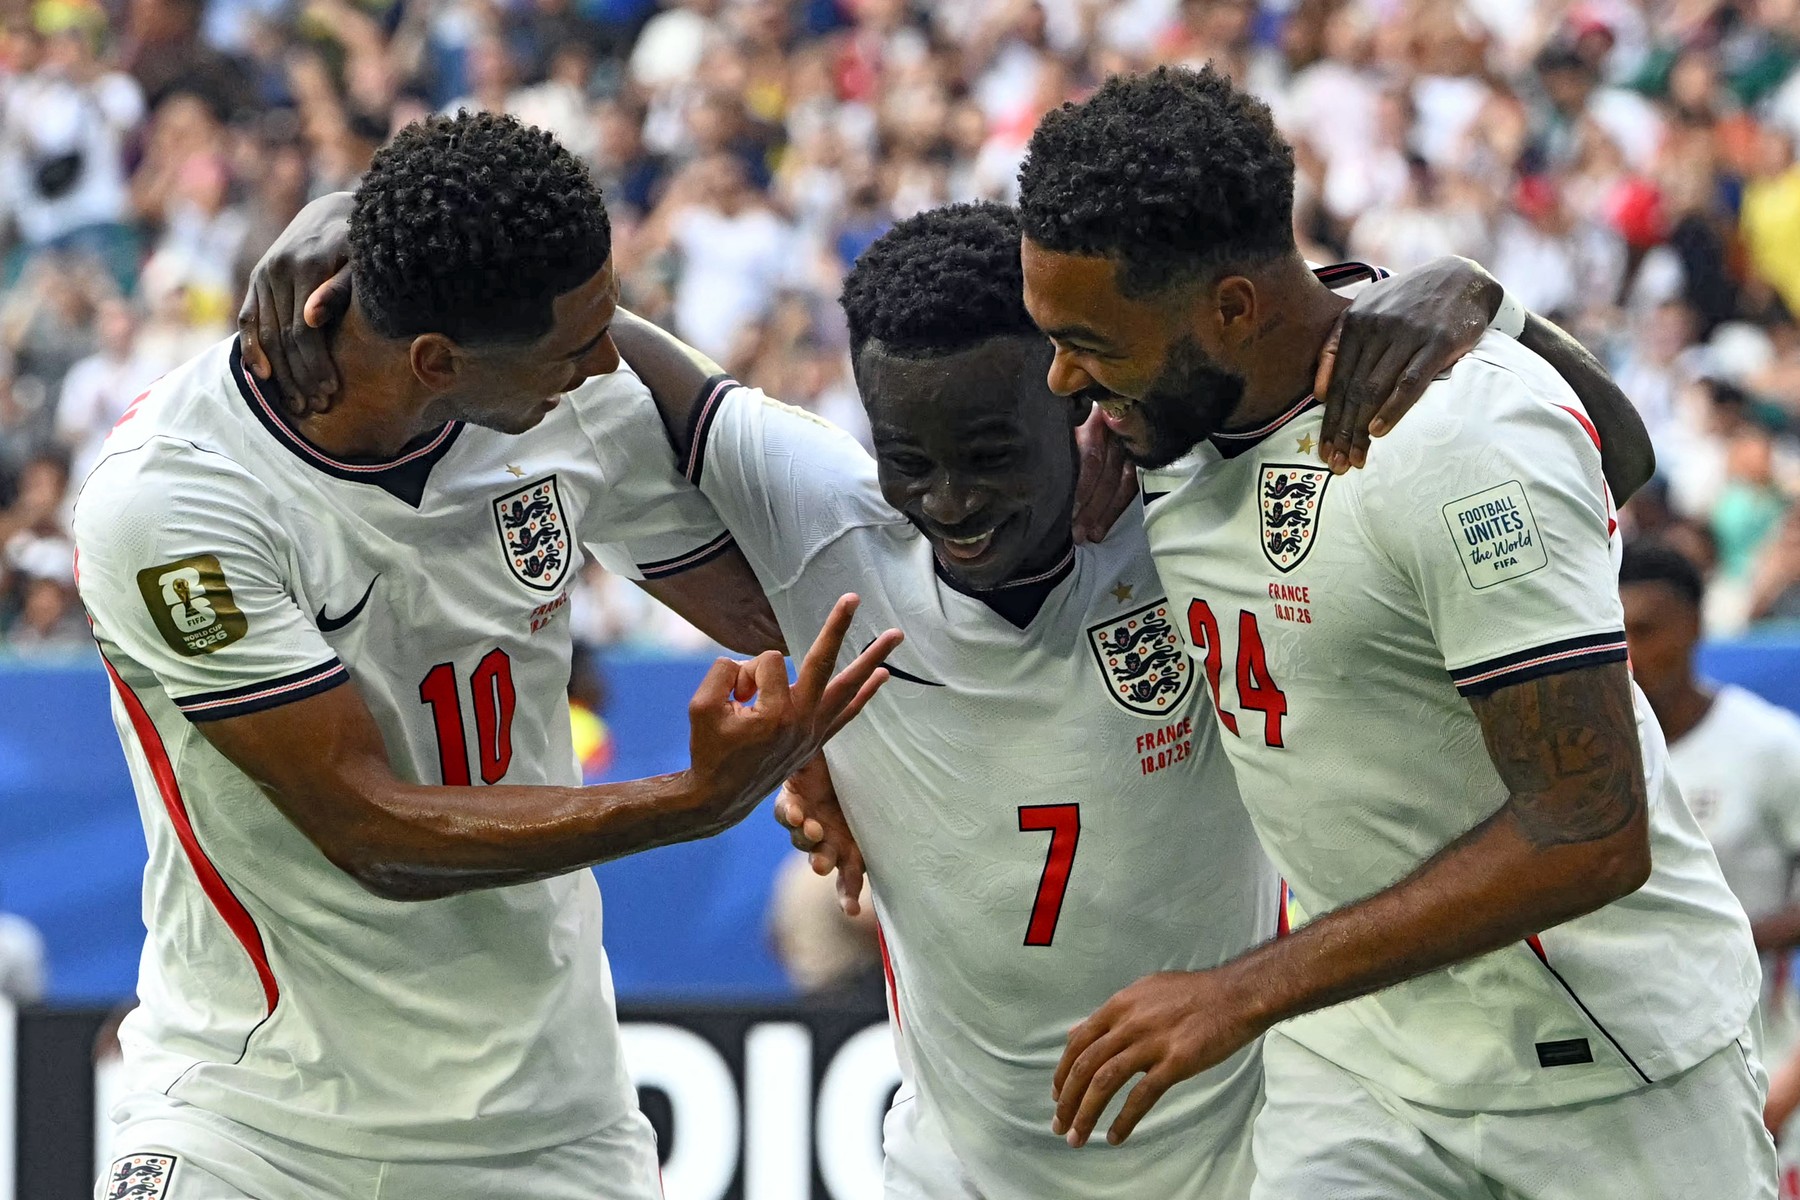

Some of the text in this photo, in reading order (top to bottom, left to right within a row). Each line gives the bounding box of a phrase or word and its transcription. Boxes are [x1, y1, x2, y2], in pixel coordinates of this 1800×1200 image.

[1458, 496, 1517, 527] FOOTBALL
[1463, 510, 1524, 546] UNITES
[1469, 529, 1533, 565] the World
[1493, 556, 1518, 571] FIFA
[1268, 582, 1311, 604] FRANCE
[187, 616, 207, 627] FIFA
[1274, 603, 1312, 624] 18.07.26
[183, 623, 223, 642] WORLD CUP
[187, 630, 228, 650] 2026
[1187, 597, 1288, 749] 24
[418, 646, 517, 786] 10
[1136, 716, 1192, 754] FRANCE
[1141, 740, 1190, 776] 18.07.26
[1017, 802, 1081, 947] 7
